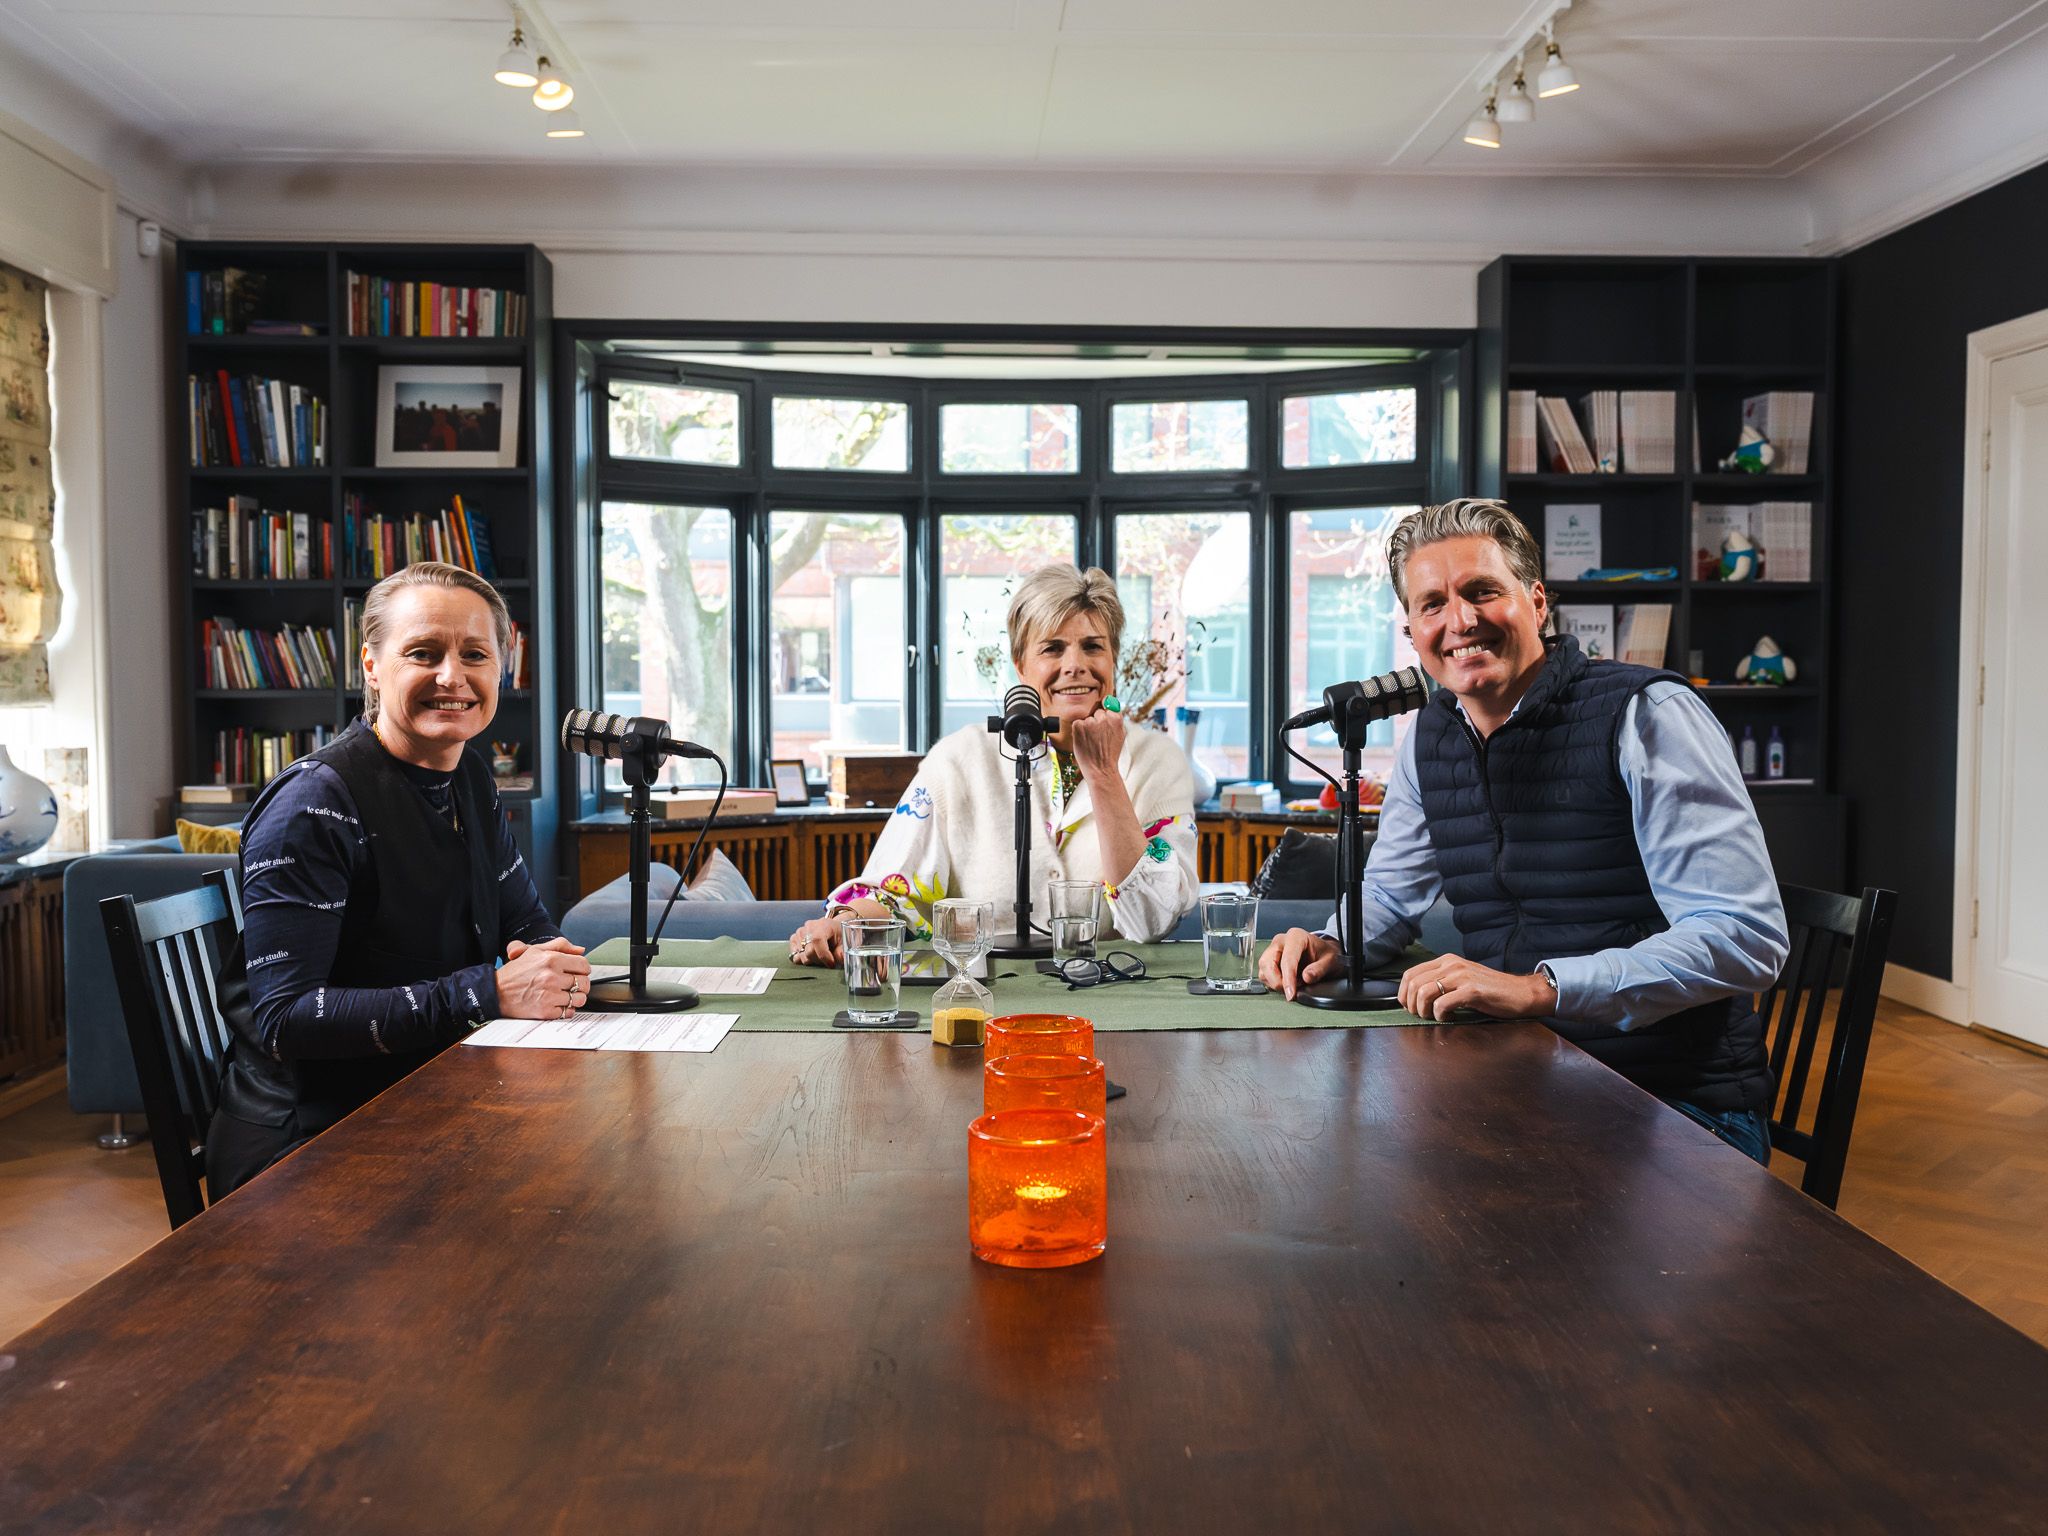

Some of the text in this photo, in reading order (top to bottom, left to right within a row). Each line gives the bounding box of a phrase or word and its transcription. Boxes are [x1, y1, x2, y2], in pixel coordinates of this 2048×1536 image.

[306, 806, 314, 814] le
[314, 807, 331, 816] cafe
[331, 811, 345, 821] noir
[258, 858, 272, 868] noir
[273, 856, 296, 866] studio
[317, 902, 332, 910] noir
[252, 955, 265, 966] noir
[265, 950, 289, 962] studio
[315, 993, 325, 1009] cafe
[467, 987, 481, 1007] studio
[316, 1009, 324, 1018] le
